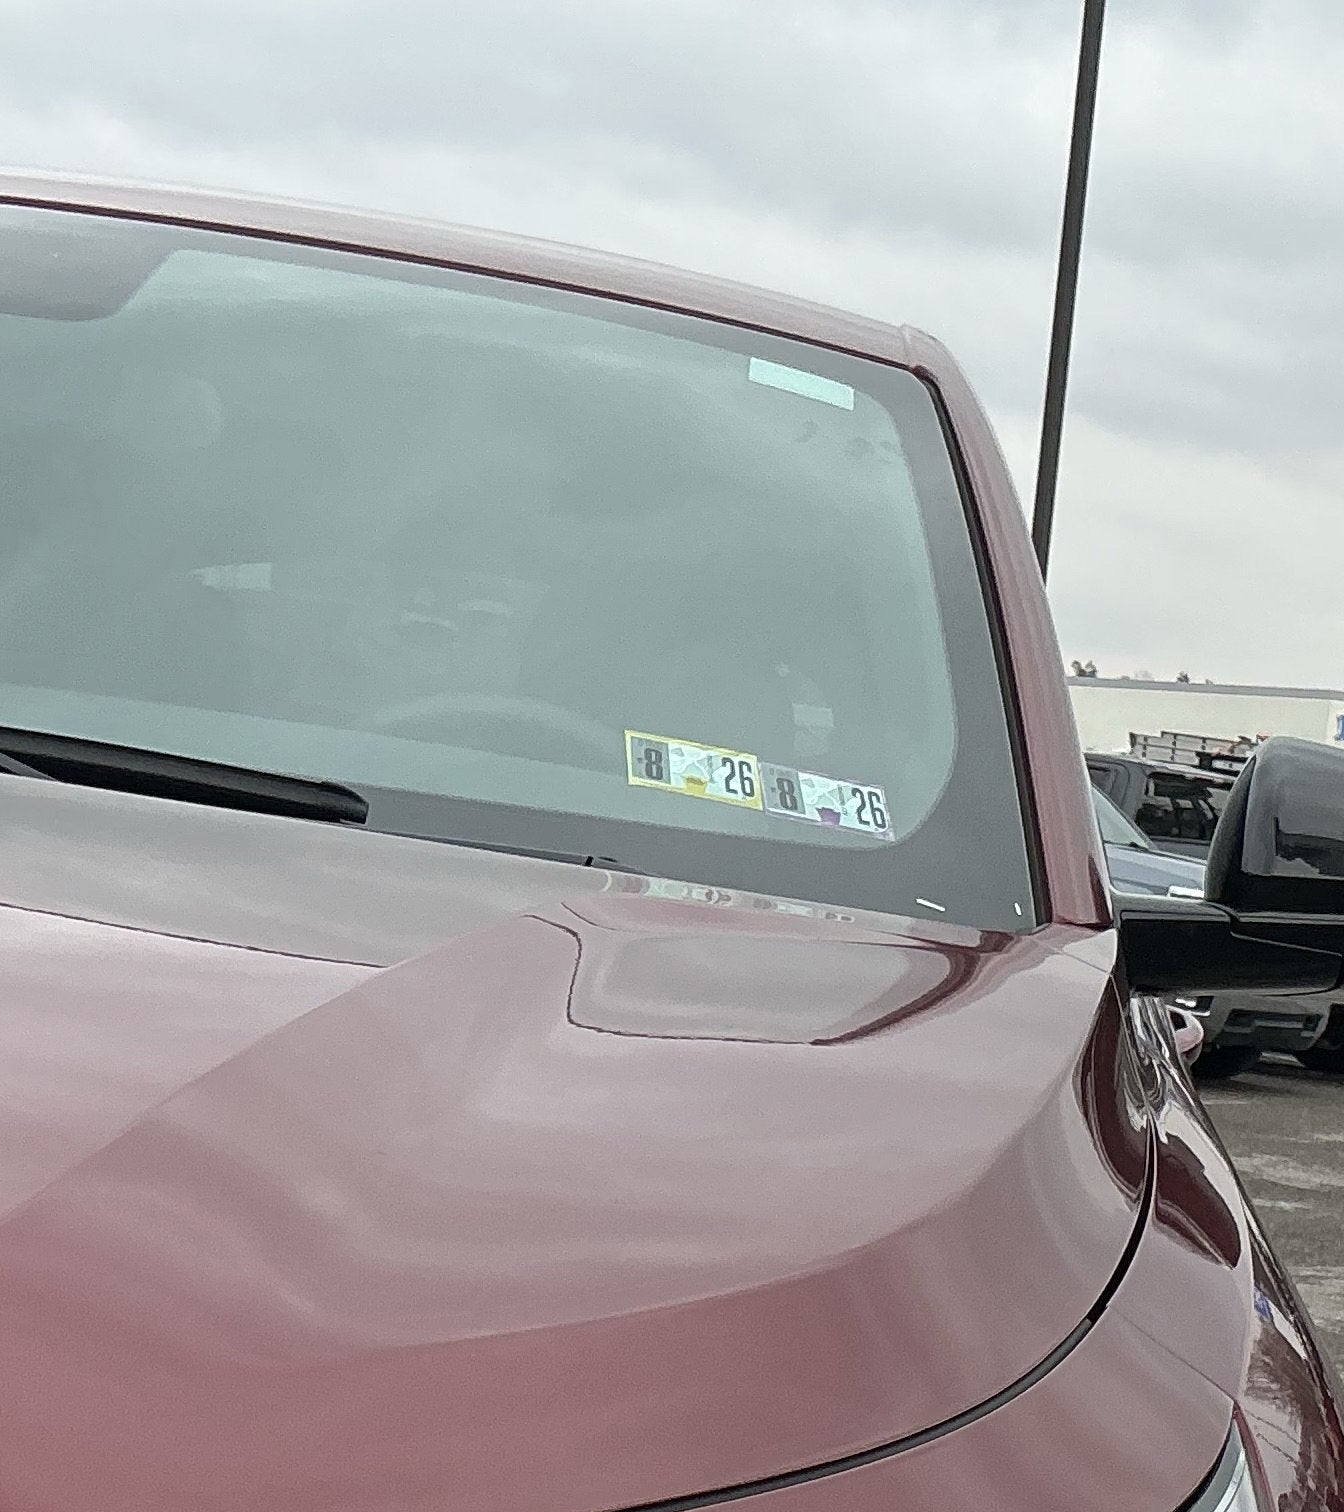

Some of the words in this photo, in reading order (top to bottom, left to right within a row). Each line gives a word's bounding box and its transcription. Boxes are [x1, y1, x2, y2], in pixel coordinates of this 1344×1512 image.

[644, 747, 664, 781] 8
[721, 756, 755, 798] 26
[776, 777, 798, 811] 8
[851, 787, 887, 829] 26
